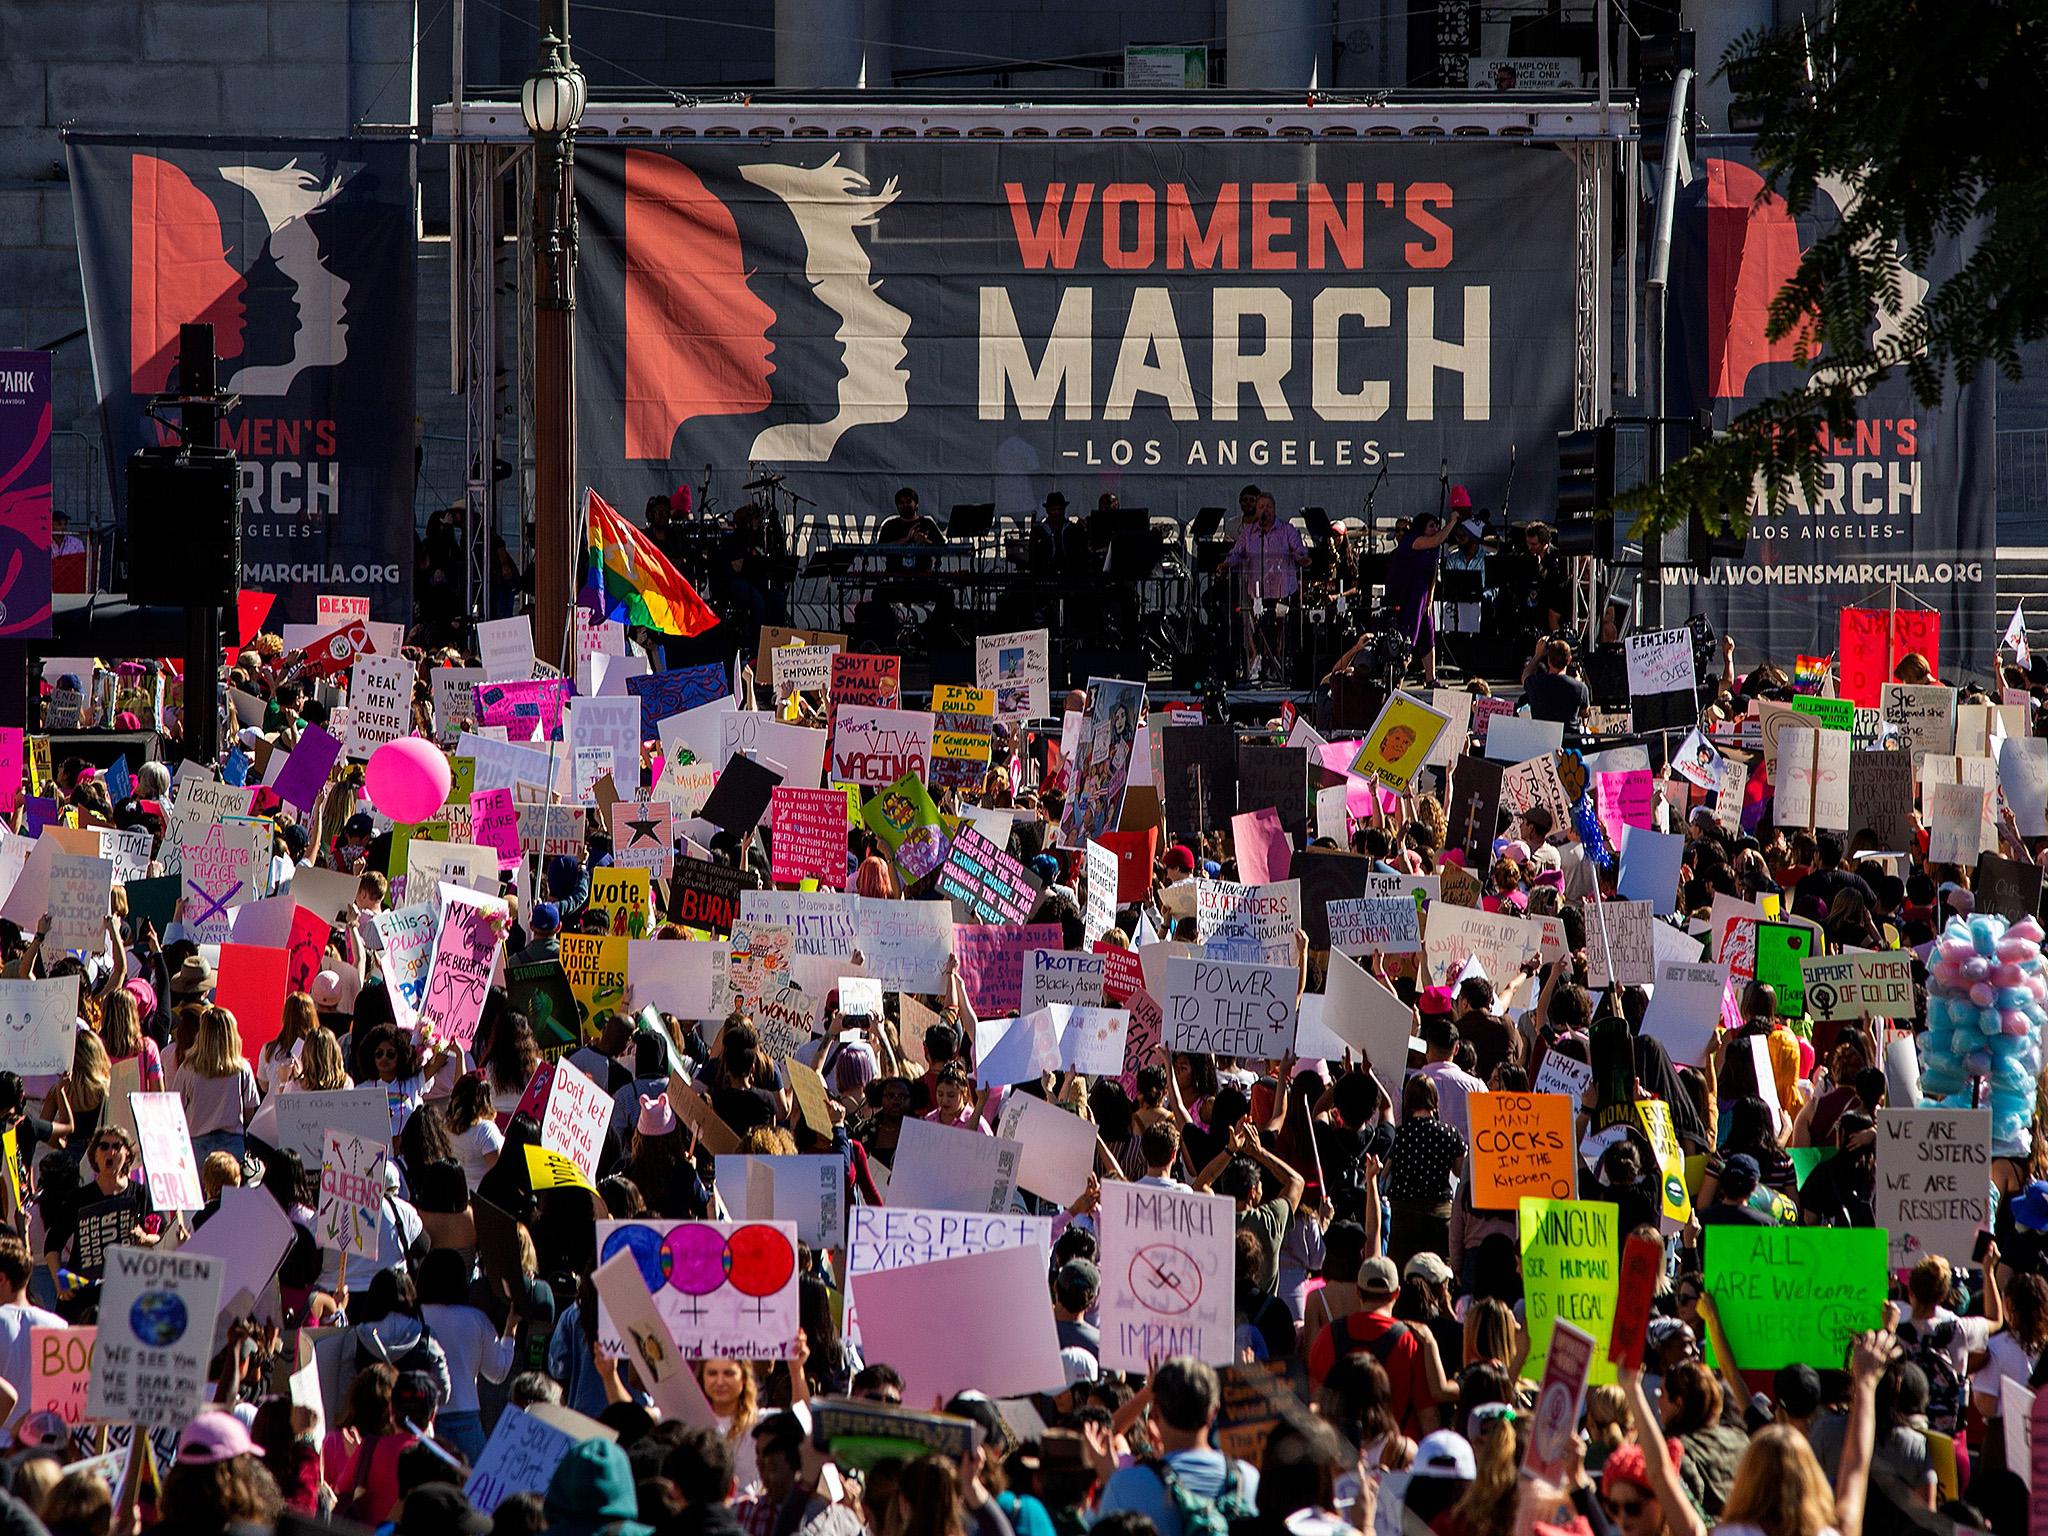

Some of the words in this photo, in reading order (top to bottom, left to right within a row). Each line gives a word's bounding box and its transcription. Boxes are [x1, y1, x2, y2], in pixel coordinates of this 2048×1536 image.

[1513, 62, 1560, 70] EMPLOYEE
[1538, 71, 1561, 79] ONLY
[1003, 182, 1454, 270] WOMEN'S
[977, 285, 1492, 422] MARCH
[778, 646, 830, 658] EMPOWERED
[783, 665, 829, 678] EMPOWER
[834, 656, 870, 671] SHUT
[874, 659, 895, 673] UP
[1660, 661, 1691, 683] OVER
[368, 674, 397, 690] REAL
[834, 675, 879, 689] SMALL
[367, 693, 394, 709] MEN
[831, 692, 876, 706] HANDS
[946, 687, 962, 698] IF
[964, 688, 983, 700] YOU
[1891, 687, 1916, 710] She
[942, 701, 976, 712] BUILD
[1796, 703, 1850, 715] MILLENNIALS
[1886, 707, 1925, 719] Believed
[1927, 707, 1945, 718] she
[358, 711, 399, 728] REVERE
[934, 715, 947, 731] A
[954, 715, 991, 732] WALL
[1605, 719, 1628, 734] NOSE
[1900, 726, 1923, 736] she
[864, 730, 926, 755] VIVA
[945, 747, 970, 757] WILL
[835, 752, 926, 787] VAGINA
[184, 777, 218, 806] Teach
[776, 790, 788, 799] TO
[792, 791, 809, 800] THE
[475, 794, 505, 812] THE
[773, 800, 795, 809] THAT
[796, 803, 819, 812] NEED
[187, 808, 200, 822] to
[472, 813, 514, 834] FUTURE
[791, 812, 847, 826] RESISTANCE
[205, 824, 226, 848] A
[487, 833, 505, 848] IS
[772, 832, 794, 842] NEED
[796, 836, 846, 852] ASSISTANCE
[820, 830, 844, 840] THAT
[118, 834, 152, 857] TIME
[182, 845, 249, 865] WOMAN'S
[773, 841, 789, 852] THE
[790, 844, 823, 857] FUTURE
[962, 825, 967, 836] I
[965, 828, 980, 846] AM
[980, 839, 995, 855] NO
[994, 848, 1024, 878] LONGER
[773, 852, 788, 860] THE
[790, 854, 832, 867] DISTANCE
[952, 834, 995, 871] ACCEPTING
[995, 864, 1010, 883] THE
[1010, 875, 1037, 903] THINGS
[1088, 854, 1116, 882] STRONG
[193, 863, 237, 882] PLACE
[947, 847, 954, 858] I
[952, 849, 984, 878] CANNOT
[1017, 897, 1032, 915] AM
[593, 879, 645, 904] vote.
[943, 861, 980, 893] CHANGING
[981, 885, 997, 905] THE
[997, 879, 1025, 926] THINGS
[1213, 881, 1260, 898] THOUGHT
[1371, 877, 1401, 894] Fight
[681, 888, 740, 929] BURN
[943, 878, 976, 906] CANNOT
[975, 900, 1006, 926] ACCEPT
[1199, 891, 1218, 909] SEX
[1220, 896, 1288, 915] OFFENDERS
[1328, 901, 1350, 914] WHY
[1356, 900, 1376, 913] DOES
[1377, 899, 1416, 912] ALCOHOL
[390, 914, 418, 933] this
[447, 901, 474, 928] MY
[1329, 913, 1361, 928] EXCUSE
[1364, 912, 1378, 926] HIS
[1380, 911, 1416, 926] ACTIONS
[1027, 929, 1058, 942] such
[1253, 922, 1295, 941] HOUSING
[1331, 929, 1349, 945] BUT
[1348, 926, 1391, 945] CONDEMN
[1389, 926, 1418, 943] MINE?
[562, 938, 604, 954] EVERY
[407, 948, 429, 978] got
[437, 951, 452, 967] ARE
[562, 953, 600, 970] VOICE
[1106, 959, 1128, 973] WITH
[1111, 952, 1138, 967] STAND
[566, 970, 625, 987] MATTERS
[1105, 969, 1142, 985] PLANNED
[1193, 964, 1276, 998] POWER
[1803, 963, 1854, 983] SUPPORT
[1858, 962, 1911, 980] WOMEN
[1076, 977, 1101, 992] Asian
[1839, 984, 1859, 1003] OF
[1861, 983, 1909, 1003] COLOR!
[427, 1004, 444, 1027] YOUR
[758, 996, 813, 1033] WOMAN'S
[1135, 997, 1163, 1034] WEAK
[1169, 995, 1200, 1022] TO
[1214, 998, 1261, 1031] THE
[1174, 1023, 1268, 1056] PEACEFUL
[1545, 1051, 1580, 1078] Little
[557, 1068, 585, 1105] Don't
[587, 1094, 606, 1127] let
[1496, 1096, 1532, 1112] TOO
[551, 1096, 592, 1152] bastards
[1494, 1113, 1541, 1128] MANY
[1887, 1120, 1913, 1140] WE
[1927, 1121, 1958, 1141] ARE
[546, 1120, 572, 1150] grind
[572, 1147, 592, 1177] you
[1475, 1129, 1565, 1153] COCKS
[1497, 1155, 1520, 1168] IN
[1526, 1151, 1552, 1165] THE
[1918, 1143, 1988, 1164] SISTERS
[151, 1171, 195, 1207] GIRL
[1493, 1171, 1551, 1188] Kitchen
[1886, 1173, 1912, 1192] WE
[1924, 1175, 1957, 1192] ARE
[321, 1169, 383, 1211] QUEENS
[1899, 1198, 1984, 1222] RESISTERS
[855, 1209, 1034, 1248] RESPECT
[1534, 1209, 1608, 1248] NINGUN
[79, 1217, 91, 1268] WHOSE
[1750, 1235, 1804, 1266] ALL
[117, 1252, 210, 1280] WOMEN
[1527, 1258, 1548, 1278] SER
[1560, 1258, 1610, 1281] HUMANO
[1713, 1271, 1763, 1299] ARE
[1772, 1275, 1868, 1300] Welcome
[1533, 1292, 1548, 1320] ES
[1557, 1293, 1604, 1321] ILEGAL
[1832, 1312, 1868, 1325] LOVE
[103, 1344, 130, 1364] WE
[137, 1351, 168, 1366] SEE
[102, 1369, 128, 1387] WE
[102, 1389, 128, 1405] WE
